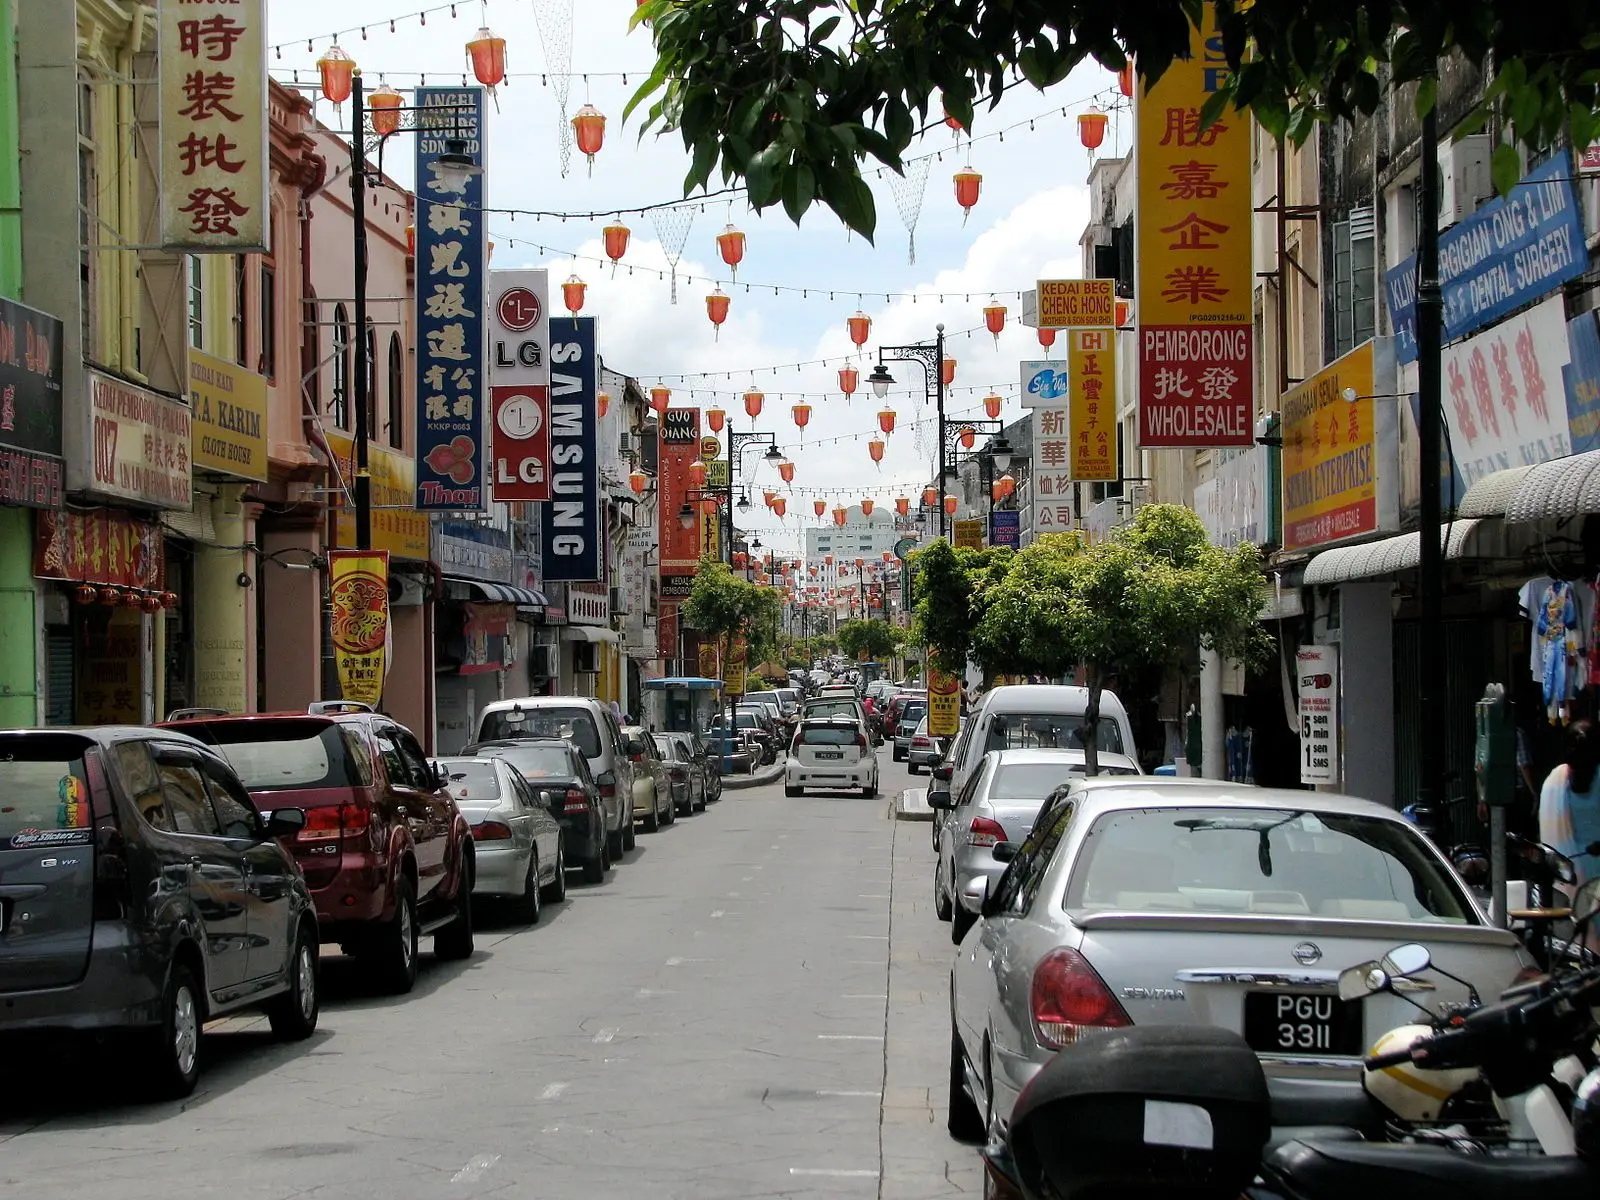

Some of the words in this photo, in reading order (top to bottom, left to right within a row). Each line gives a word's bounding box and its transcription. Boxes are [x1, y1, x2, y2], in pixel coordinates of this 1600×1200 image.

[424, 94, 477, 114] ANGEL
[177, 14, 250, 236] 時裝批發
[422, 118, 478, 138] TOURS
[421, 140, 446, 154] SDN
[1159, 107, 1230, 304] 勝嘉企業
[1492, 199, 1525, 248] ONG
[1525, 191, 1538, 229] &
[1537, 170, 1566, 221] LIM
[1469, 264, 1514, 313] DENTAL
[1514, 223, 1573, 290] SURGERY
[1041, 283, 1080, 295] KEDAI
[1084, 282, 1110, 294] BEG
[1041, 297, 1078, 315] CHENG
[1081, 296, 1111, 315] HONG
[1042, 316, 1067, 324] MOTHER
[1072, 316, 1085, 324] SON
[1086, 316, 1098, 324] SDN
[1099, 316, 1111, 324] BHD
[496, 341, 542, 367] LG
[1145, 329, 1247, 361] PEMBORONG
[1081, 354, 1103, 430] 正豐母子
[1152, 366, 1239, 400] 批發
[94, 380, 116, 414] KEDAI
[217, 400, 261, 438] KARIM
[427, 423, 451, 431] KKKP
[667, 410, 691, 422] GUO
[1147, 405, 1246, 436] WHOLESALE
[94, 415, 119, 485] 007
[202, 436, 226, 460] CLOTH
[227, 443, 253, 465] HOUSE
[551, 341, 585, 556] SAMSUNG
[497, 457, 544, 484] LG
[710, 463, 725, 475] SENG
[1315, 443, 1372, 500] ENTERPRISE
[419, 481, 480, 505] Thai
[663, 458, 671, 516] AKSESORI
[663, 519, 671, 555] MANIK
[1301, 714, 1311, 739] 15
[1313, 715, 1328, 724] sen
[1313, 728, 1329, 739] min
[1305, 744, 1311, 767] 1
[1313, 744, 1328, 753] sen
[1313, 758, 1329, 768] SMS
[1120, 986, 1185, 1001] SENTRA
[1277, 996, 1332, 1020] PGU
[1278, 1023, 1330, 1049] 3311
